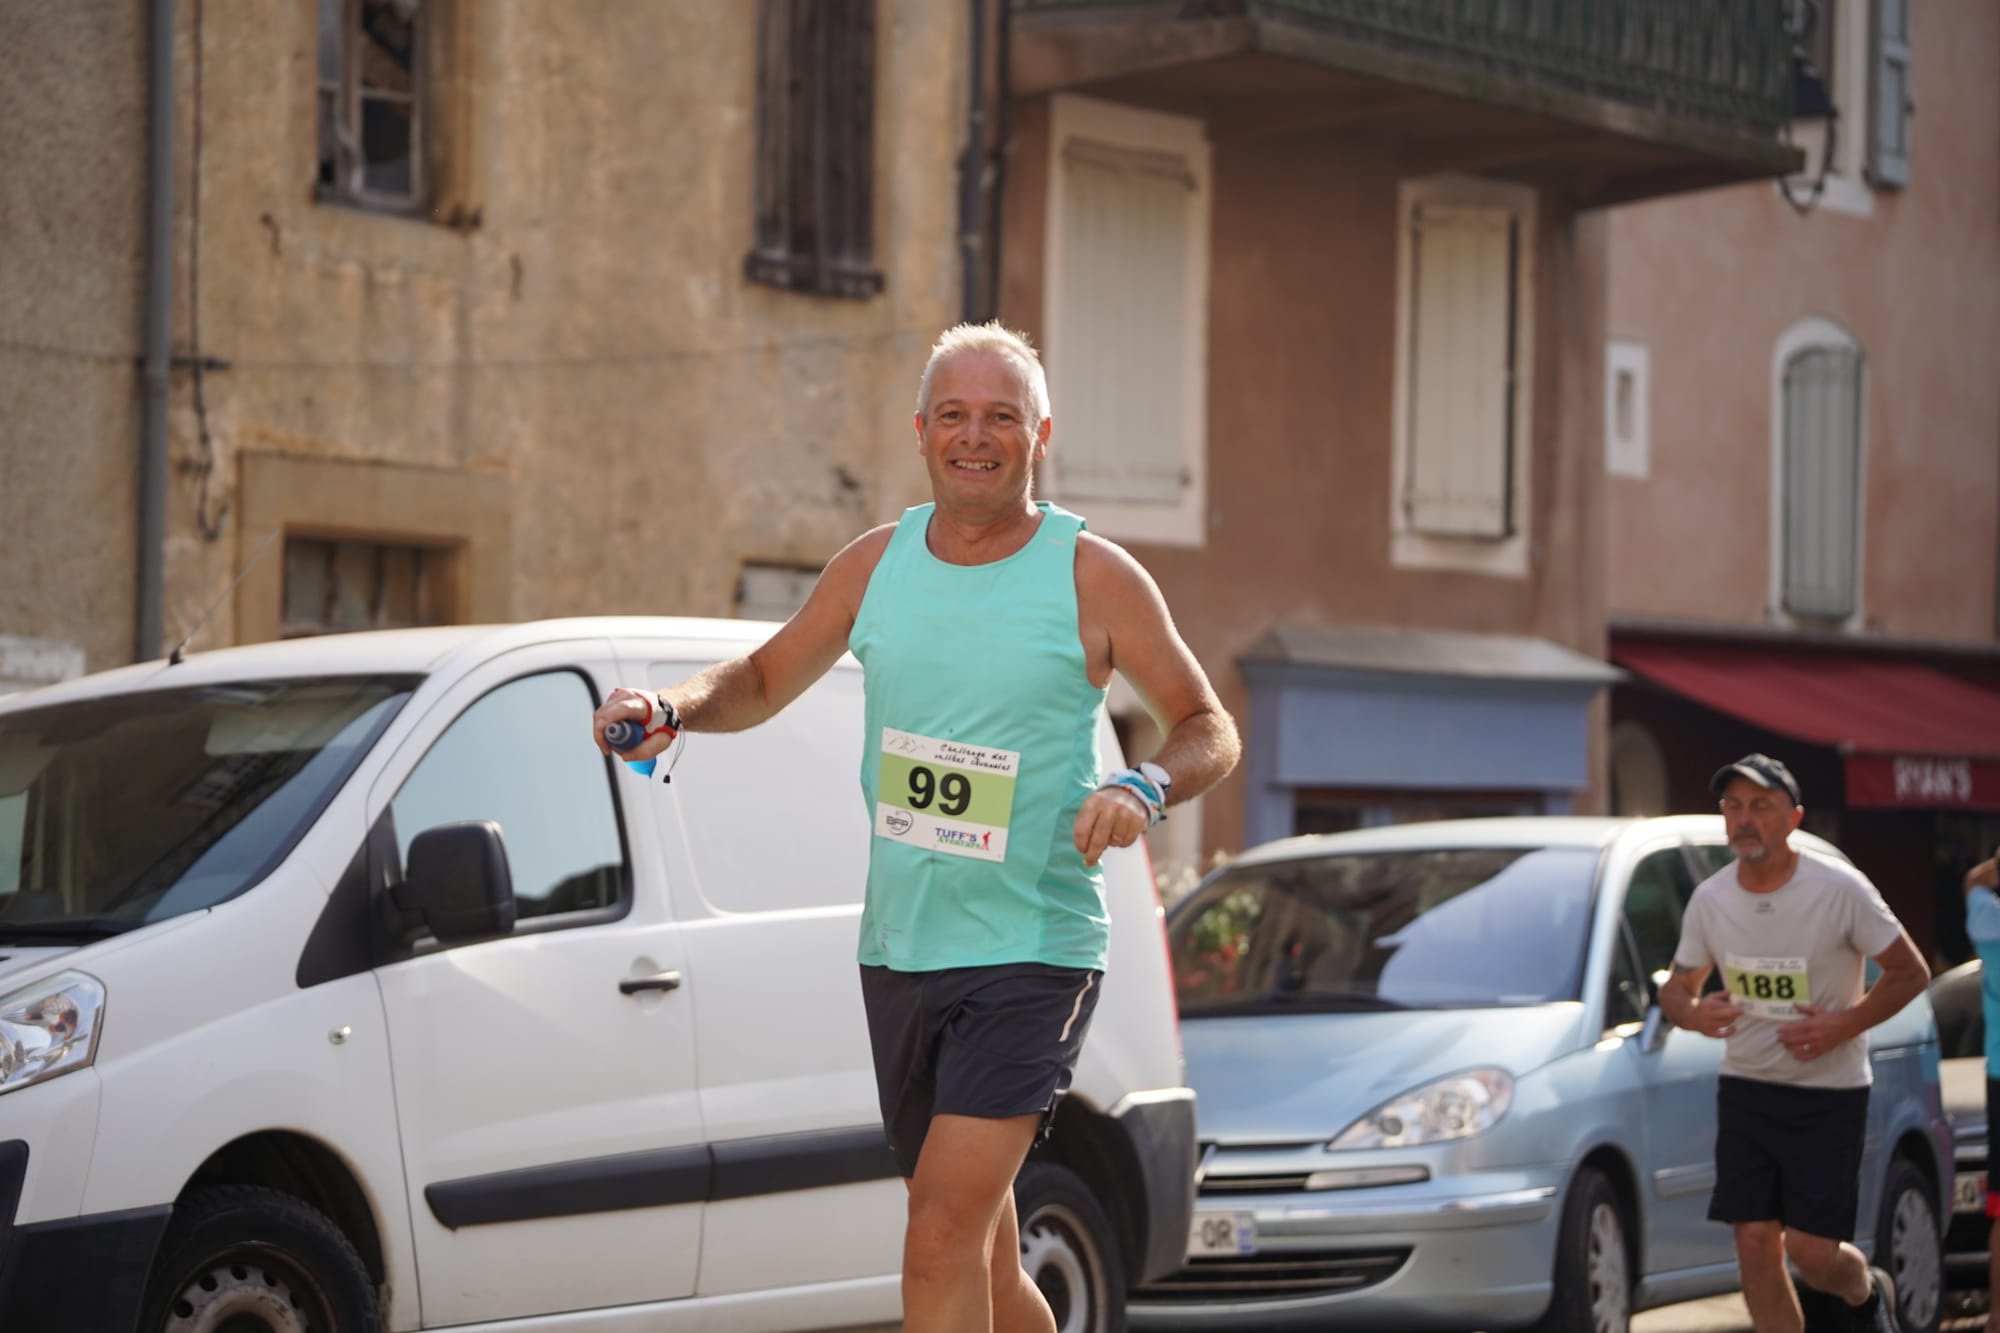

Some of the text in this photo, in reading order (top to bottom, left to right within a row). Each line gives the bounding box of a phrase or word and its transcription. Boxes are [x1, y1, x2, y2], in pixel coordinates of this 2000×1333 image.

[907, 765, 972, 816] 99
[935, 827, 977, 843] TUFF'S
[1736, 973, 1795, 999] 188
